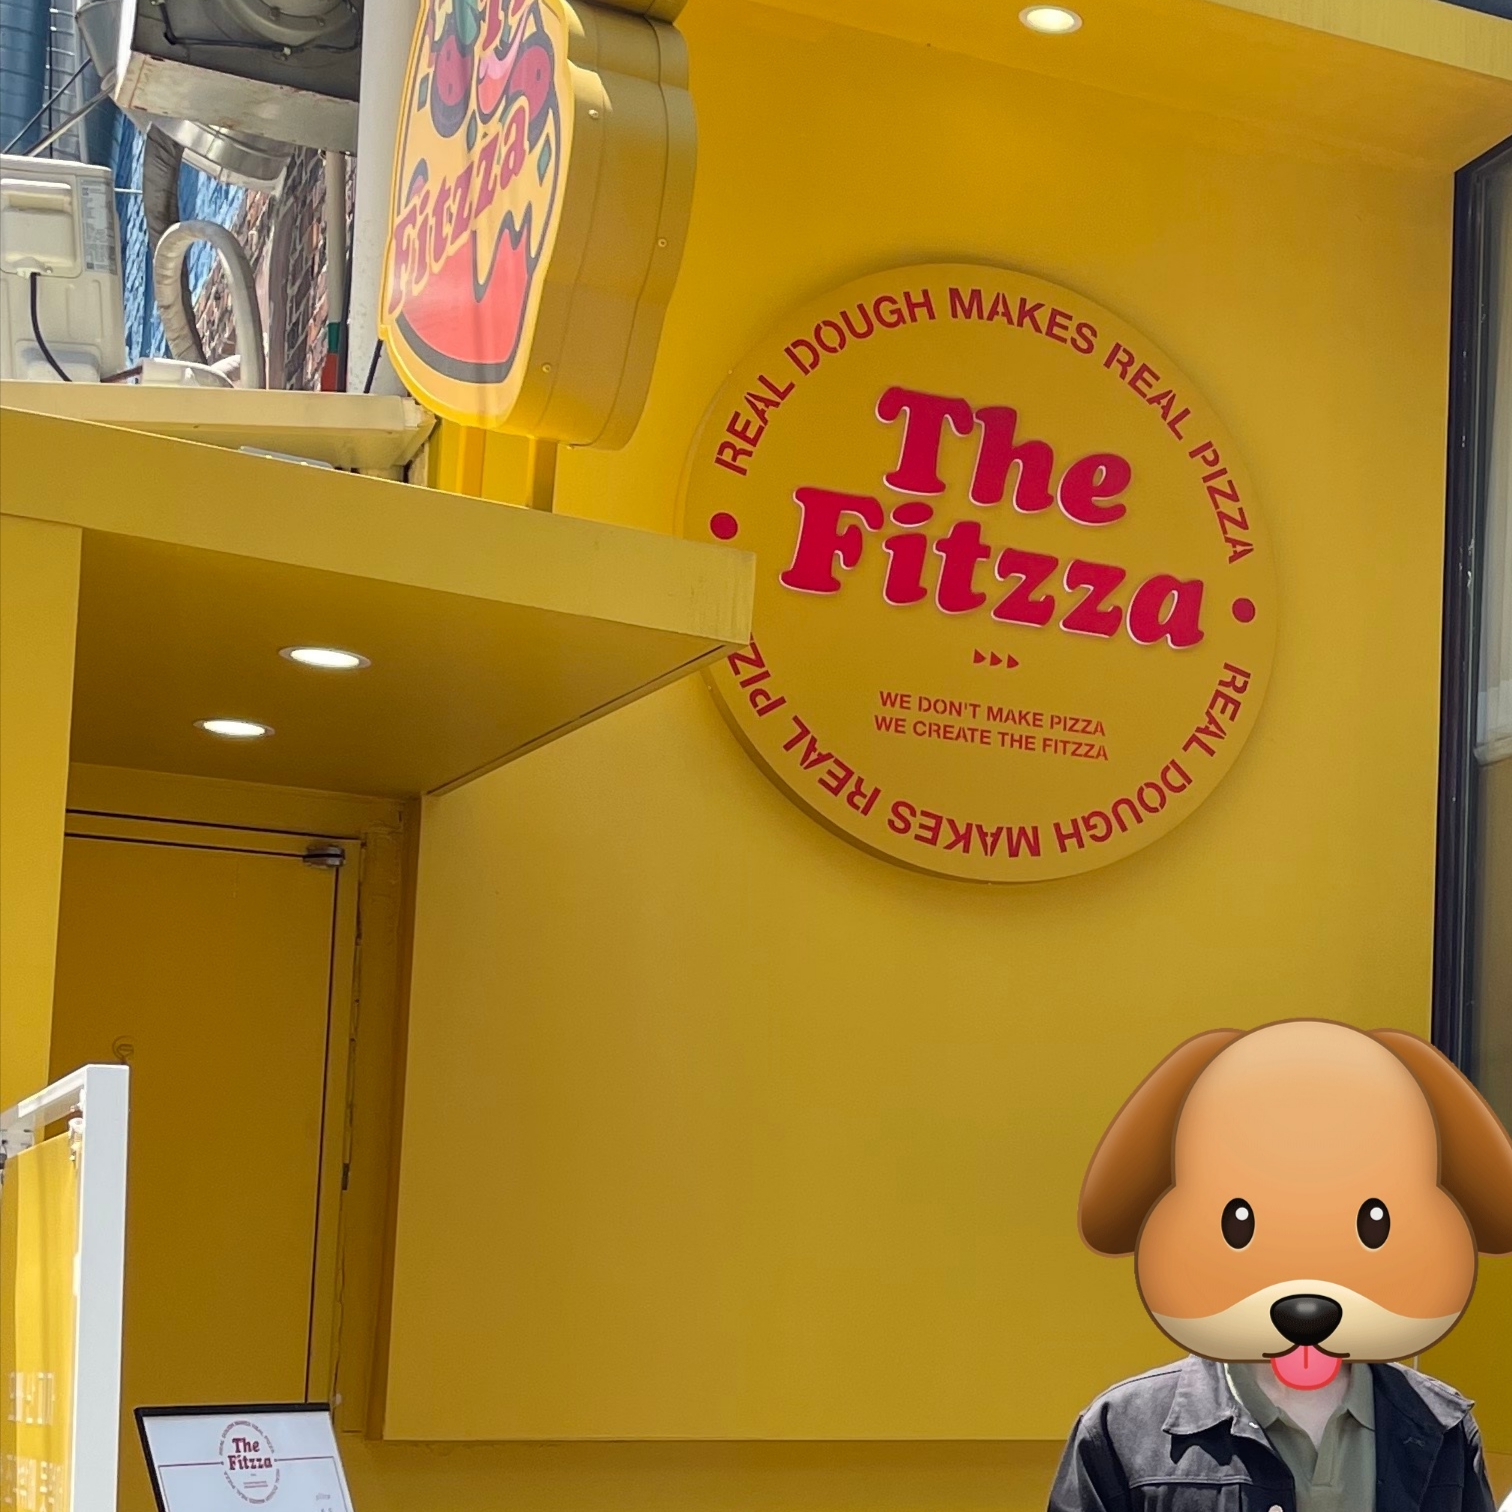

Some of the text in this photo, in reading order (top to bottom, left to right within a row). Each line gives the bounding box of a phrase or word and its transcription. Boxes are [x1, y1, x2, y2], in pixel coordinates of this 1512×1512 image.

[388, 104, 528, 315] Fitzza
[714, 287, 1254, 564] REAL DOUGH MAKES REAL PIZZA
[875, 386, 1133, 527] The
[779, 486, 1206, 651] Fitzza
[727, 632, 1252, 859] REAL DOUGH MAKES REAL PIZ
[874, 715, 1109, 761] WE CREATE THE FITZZA
[879, 690, 1106, 737] WE DON'T MAKE PIZZA
[227, 1454, 273, 1471] Fitzza
[232, 1436, 260, 1454] The
